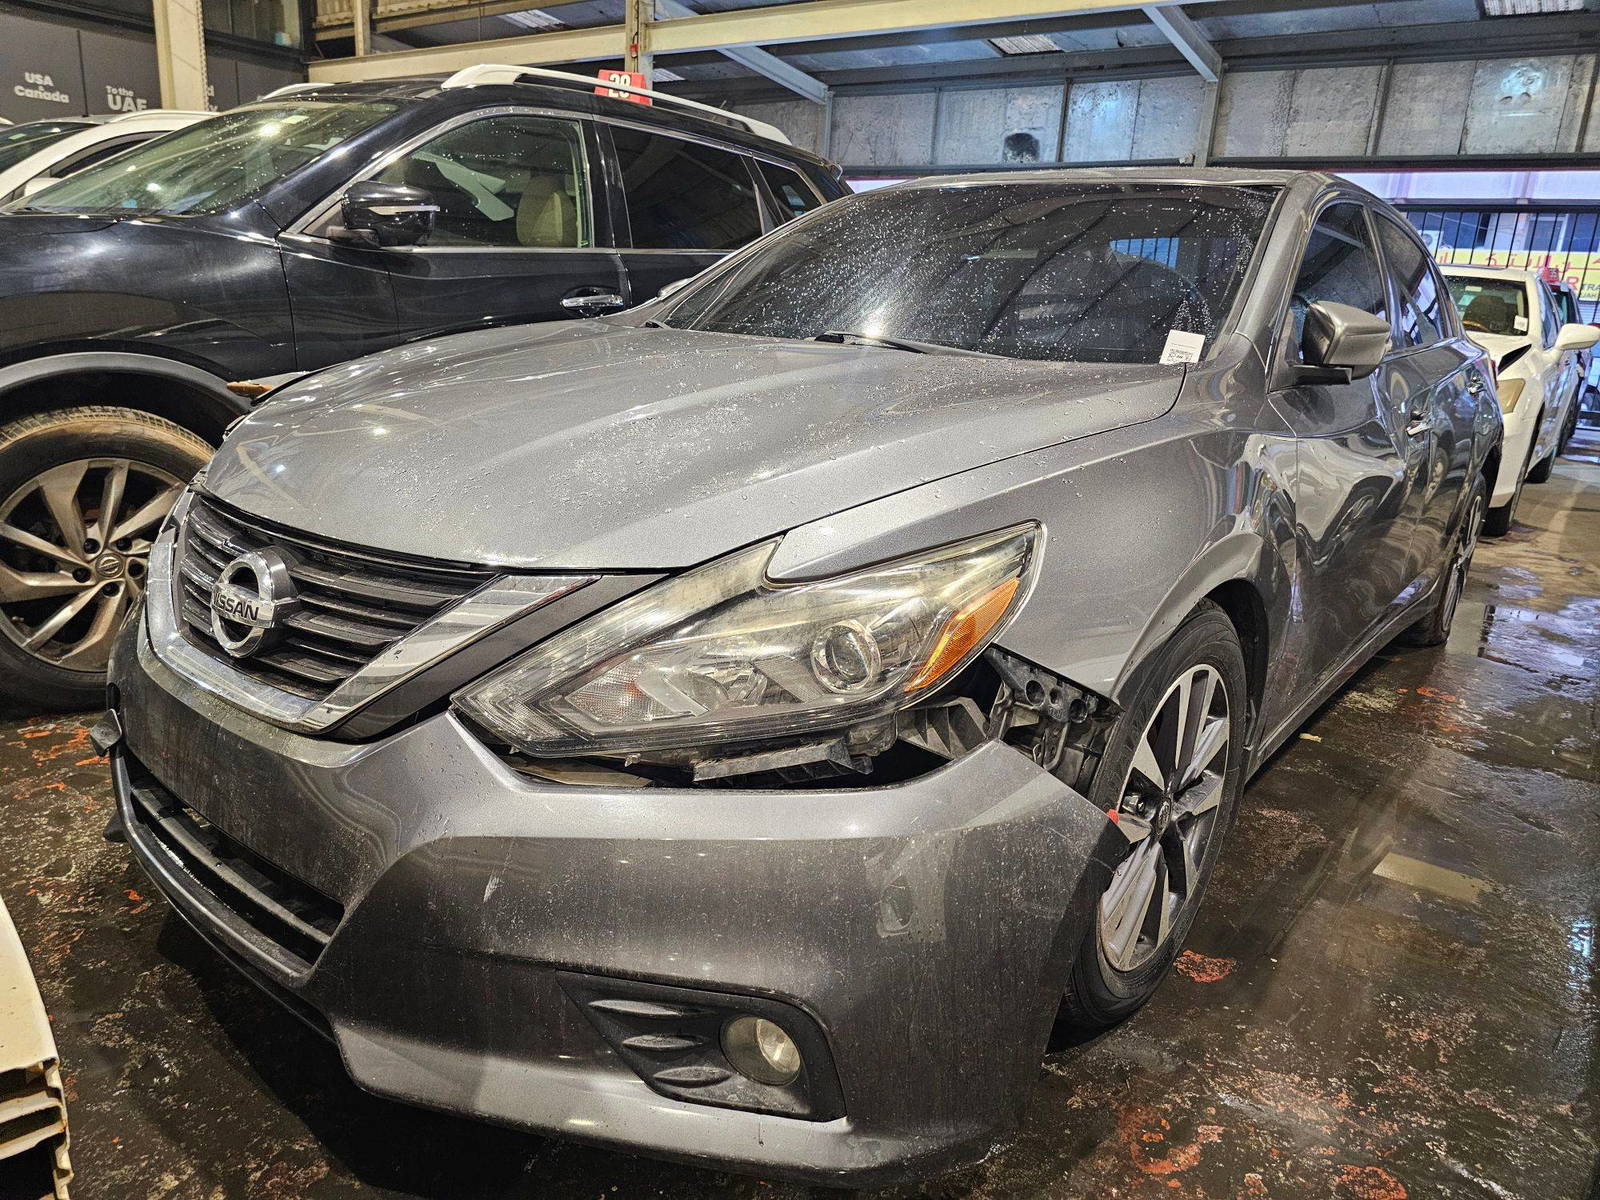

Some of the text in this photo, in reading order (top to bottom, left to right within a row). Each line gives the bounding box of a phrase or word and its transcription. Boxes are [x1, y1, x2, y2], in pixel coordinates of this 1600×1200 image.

[24, 71, 54, 86] USA
[14, 85, 70, 103] Canada
[105, 85, 135, 97] To the
[107, 94, 148, 112] UAE
[213, 591, 260, 621] NISSAN
